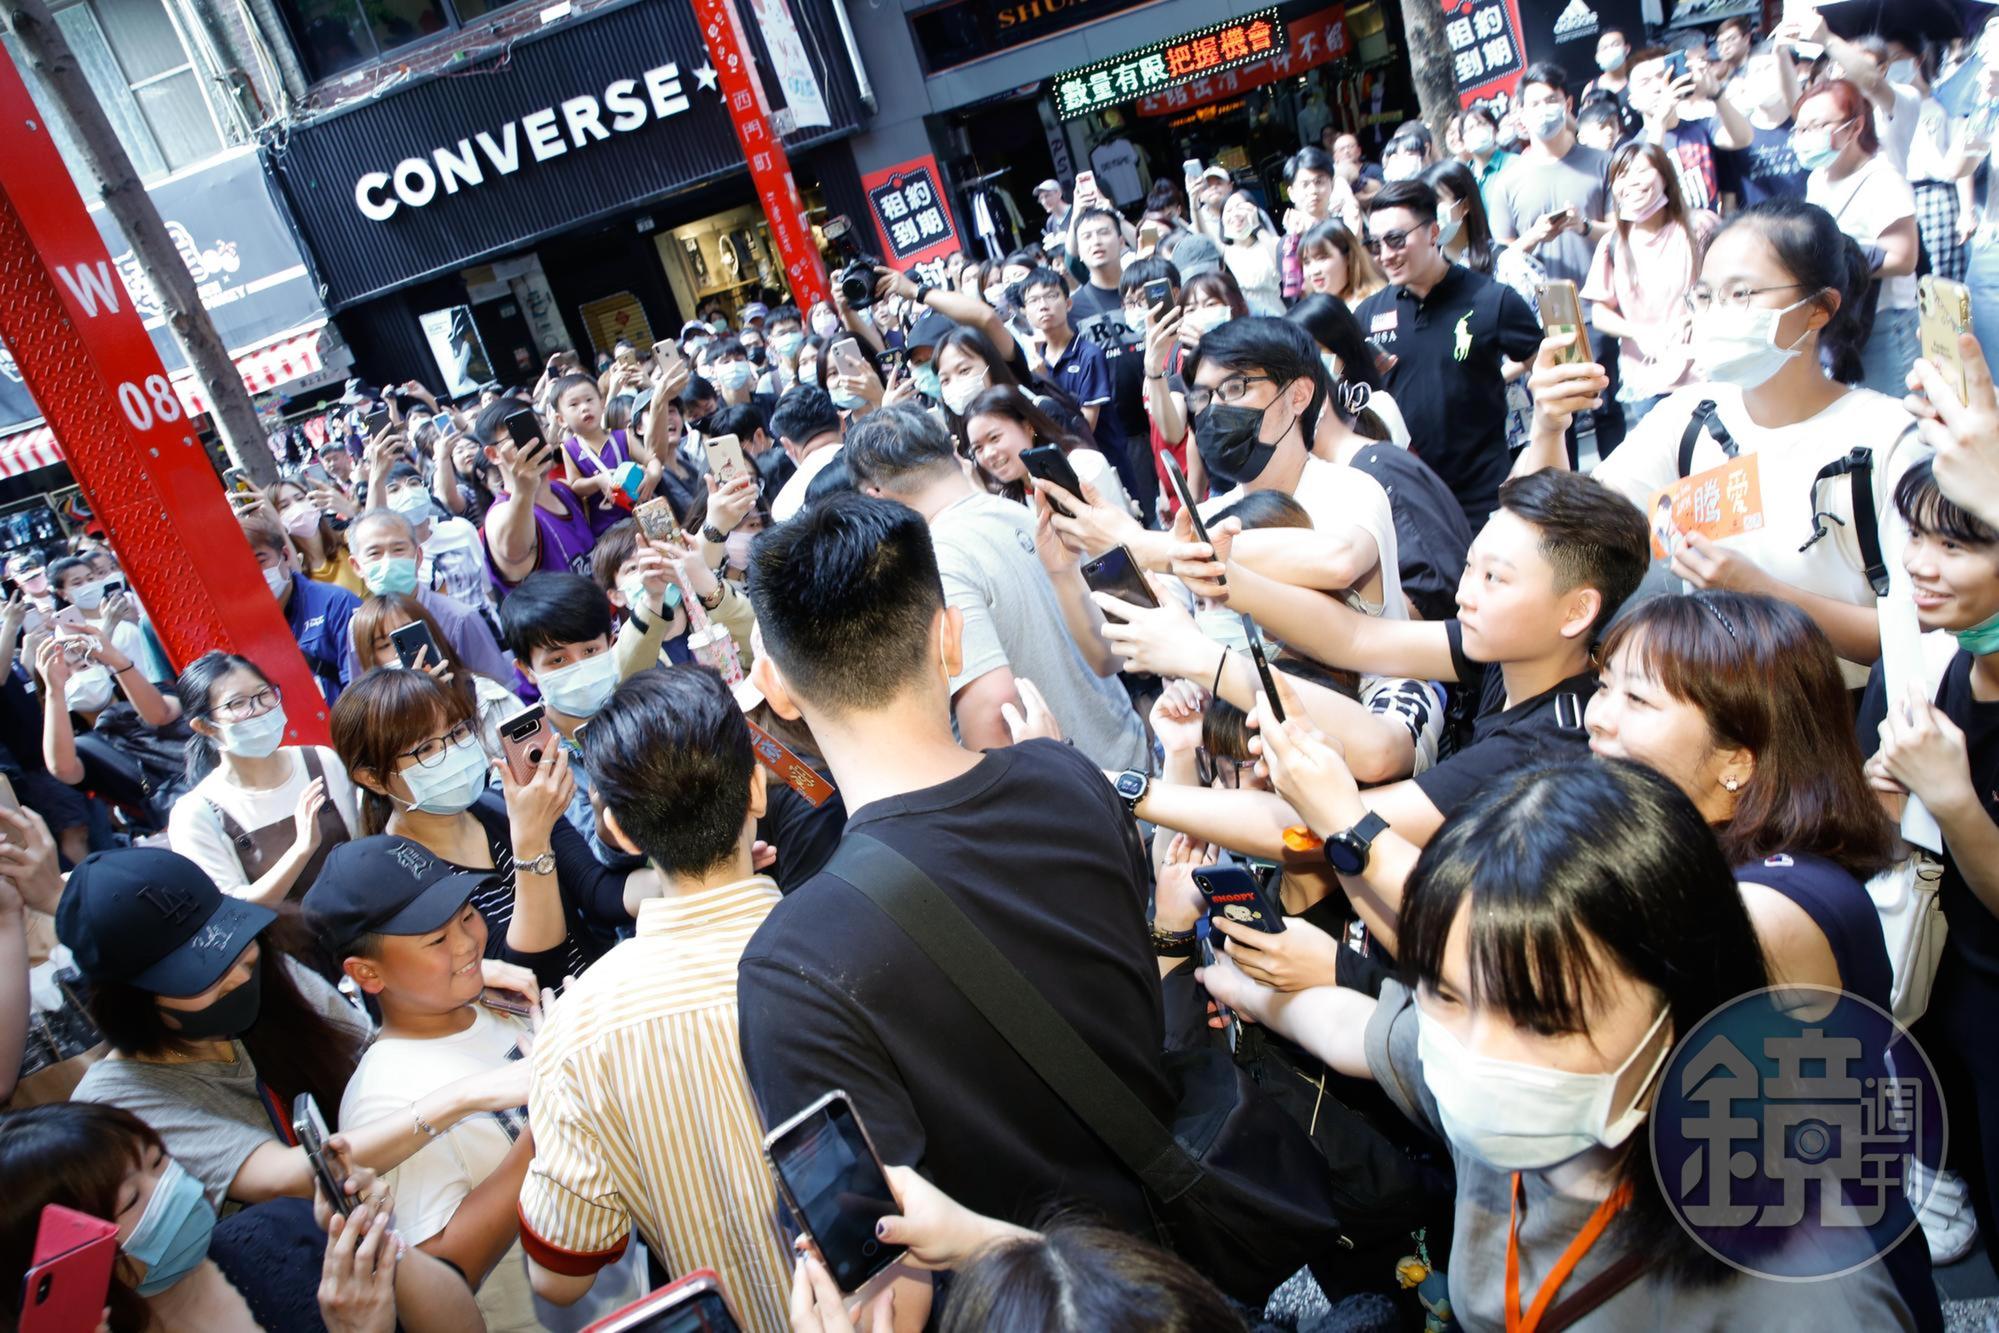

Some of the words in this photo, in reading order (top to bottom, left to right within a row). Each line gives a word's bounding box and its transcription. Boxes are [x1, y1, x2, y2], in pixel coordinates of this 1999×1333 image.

[1455, 34, 1513, 83] 到期
[355, 62, 690, 221] CONVERSE
[732, 89, 772, 172] 西門町
[880, 180, 931, 221] 租約
[891, 206, 944, 249] 到期
[55, 260, 120, 318] W
[1373, 330, 1397, 346] USA
[117, 373, 181, 431] 08
[1211, 891, 1256, 904] SNOOPY
